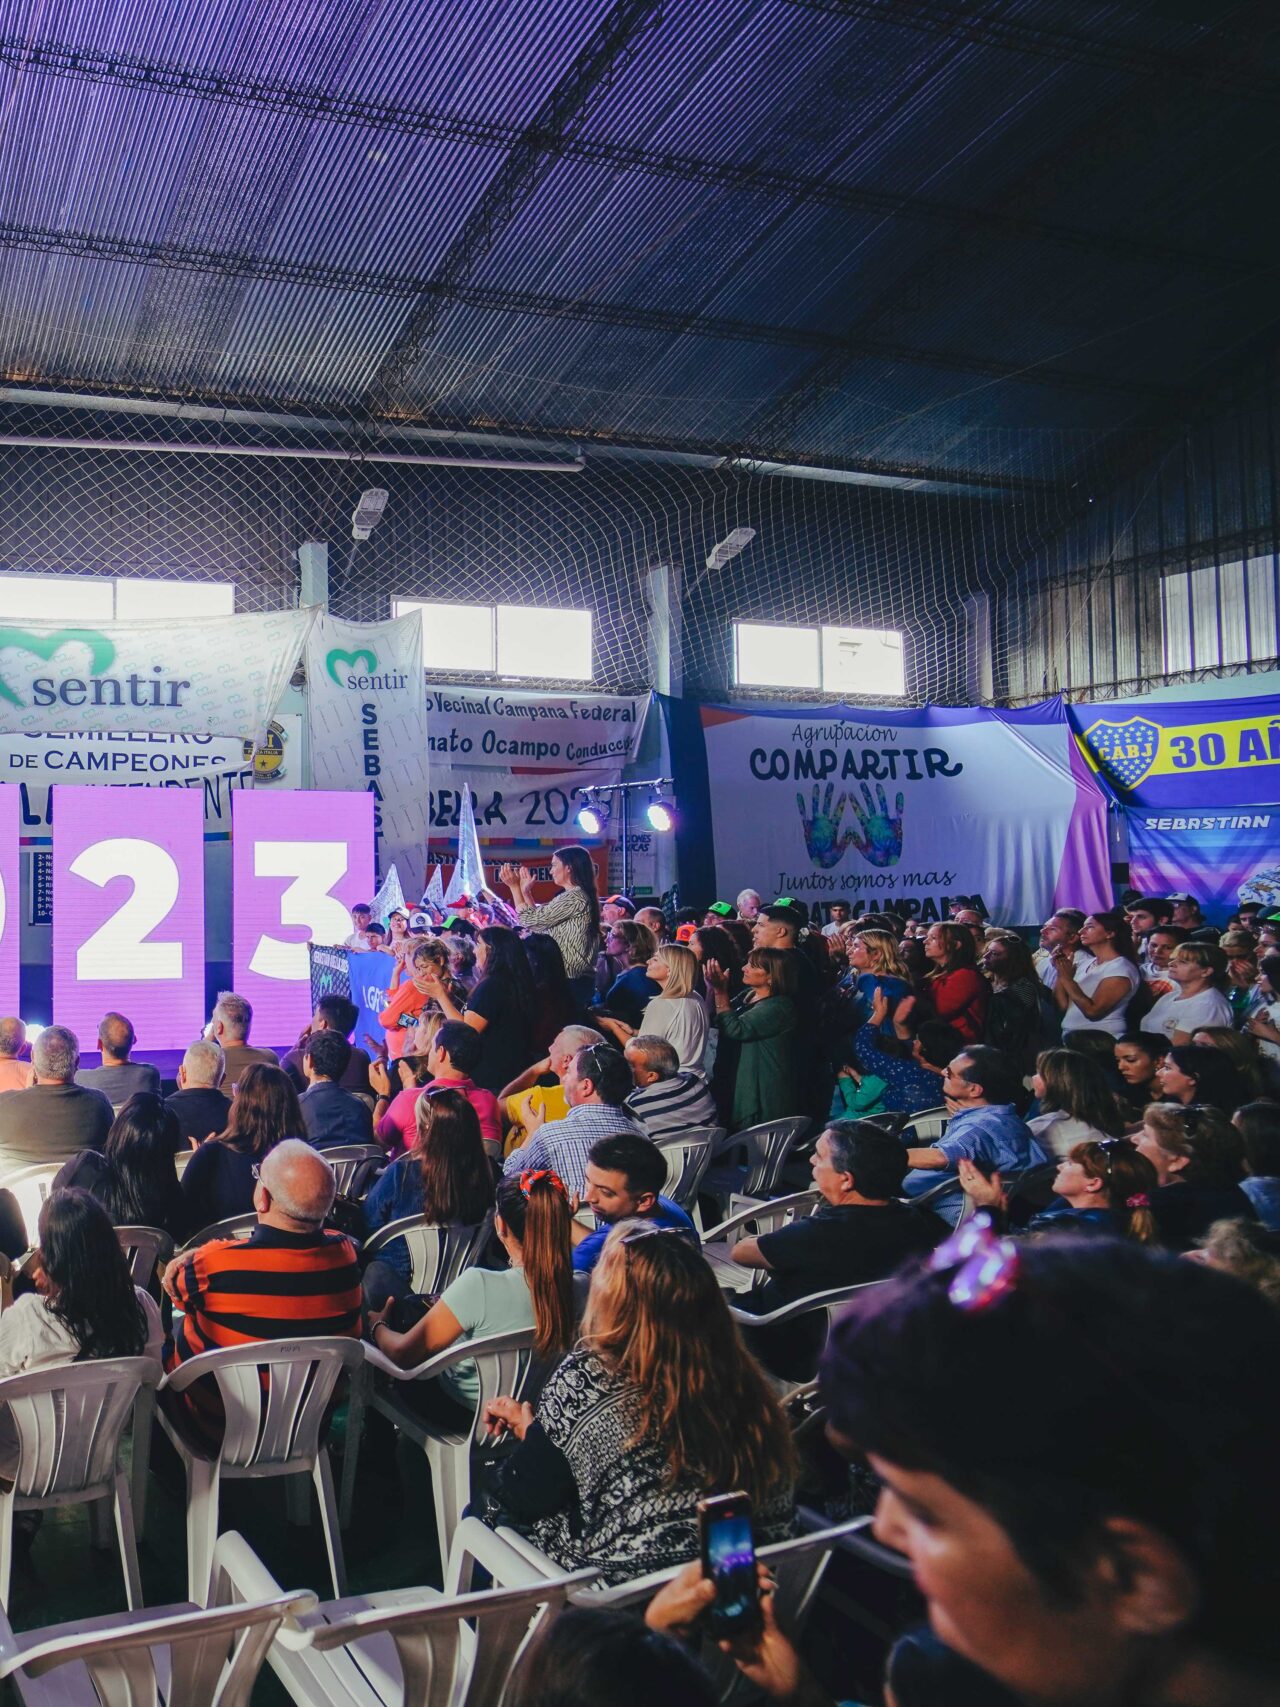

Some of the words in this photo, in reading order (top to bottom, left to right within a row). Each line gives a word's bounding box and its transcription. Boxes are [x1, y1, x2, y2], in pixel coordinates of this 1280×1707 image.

[32, 665, 191, 708] sentir
[347, 668, 408, 690] sentir
[434, 691, 493, 714] Vecinal
[493, 696, 570, 721] Campana
[571, 700, 637, 723] Federal
[481, 729, 561, 761] Ocampo
[1098, 742, 1154, 761] CABJ
[1169, 732, 1227, 769] 30
[10, 753, 38, 769] DE
[749, 747, 963, 781] COMPARTIR
[1144, 815, 1271, 831] SEBASTIAN
[774, 870, 838, 896] Juntos
[839, 872, 899, 893] somos
[902, 869, 957, 887] mas
[852, 893, 991, 924] CAMPAA
